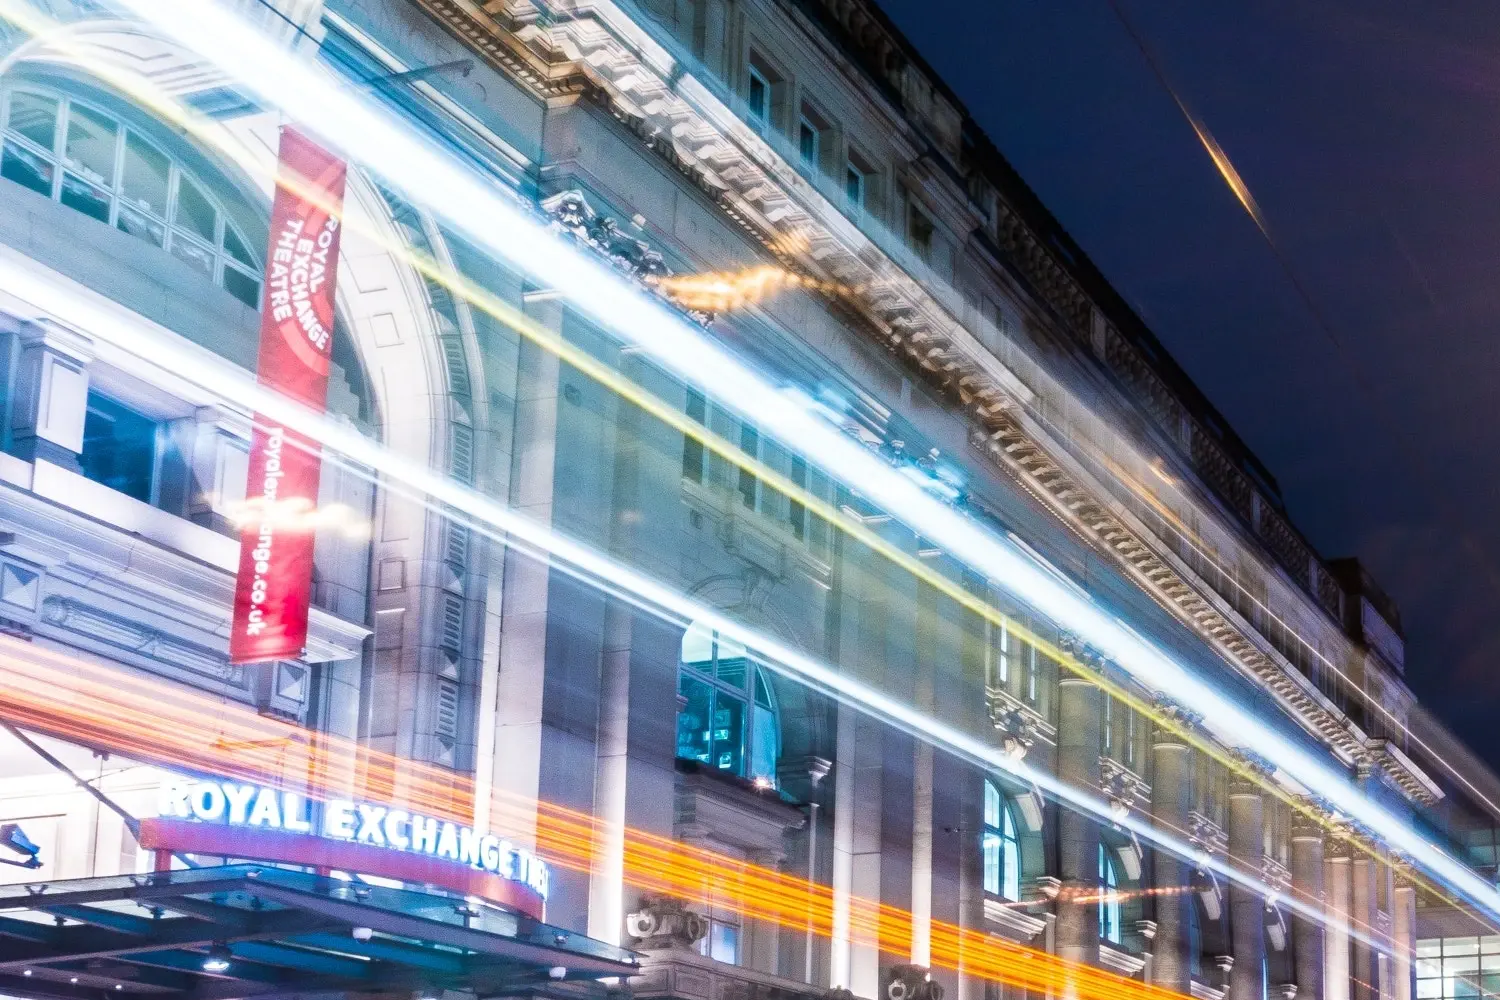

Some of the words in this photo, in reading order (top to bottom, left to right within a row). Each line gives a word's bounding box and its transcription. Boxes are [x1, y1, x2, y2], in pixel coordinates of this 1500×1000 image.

[270, 219, 304, 322] THEATRE
[290, 238, 329, 350] EXCHANGE
[310, 214, 339, 293] ROYAL
[246, 427, 284, 636] royalexange.co.uk
[158, 780, 310, 831] ROYAL
[327, 801, 514, 879] EXCHANGE
